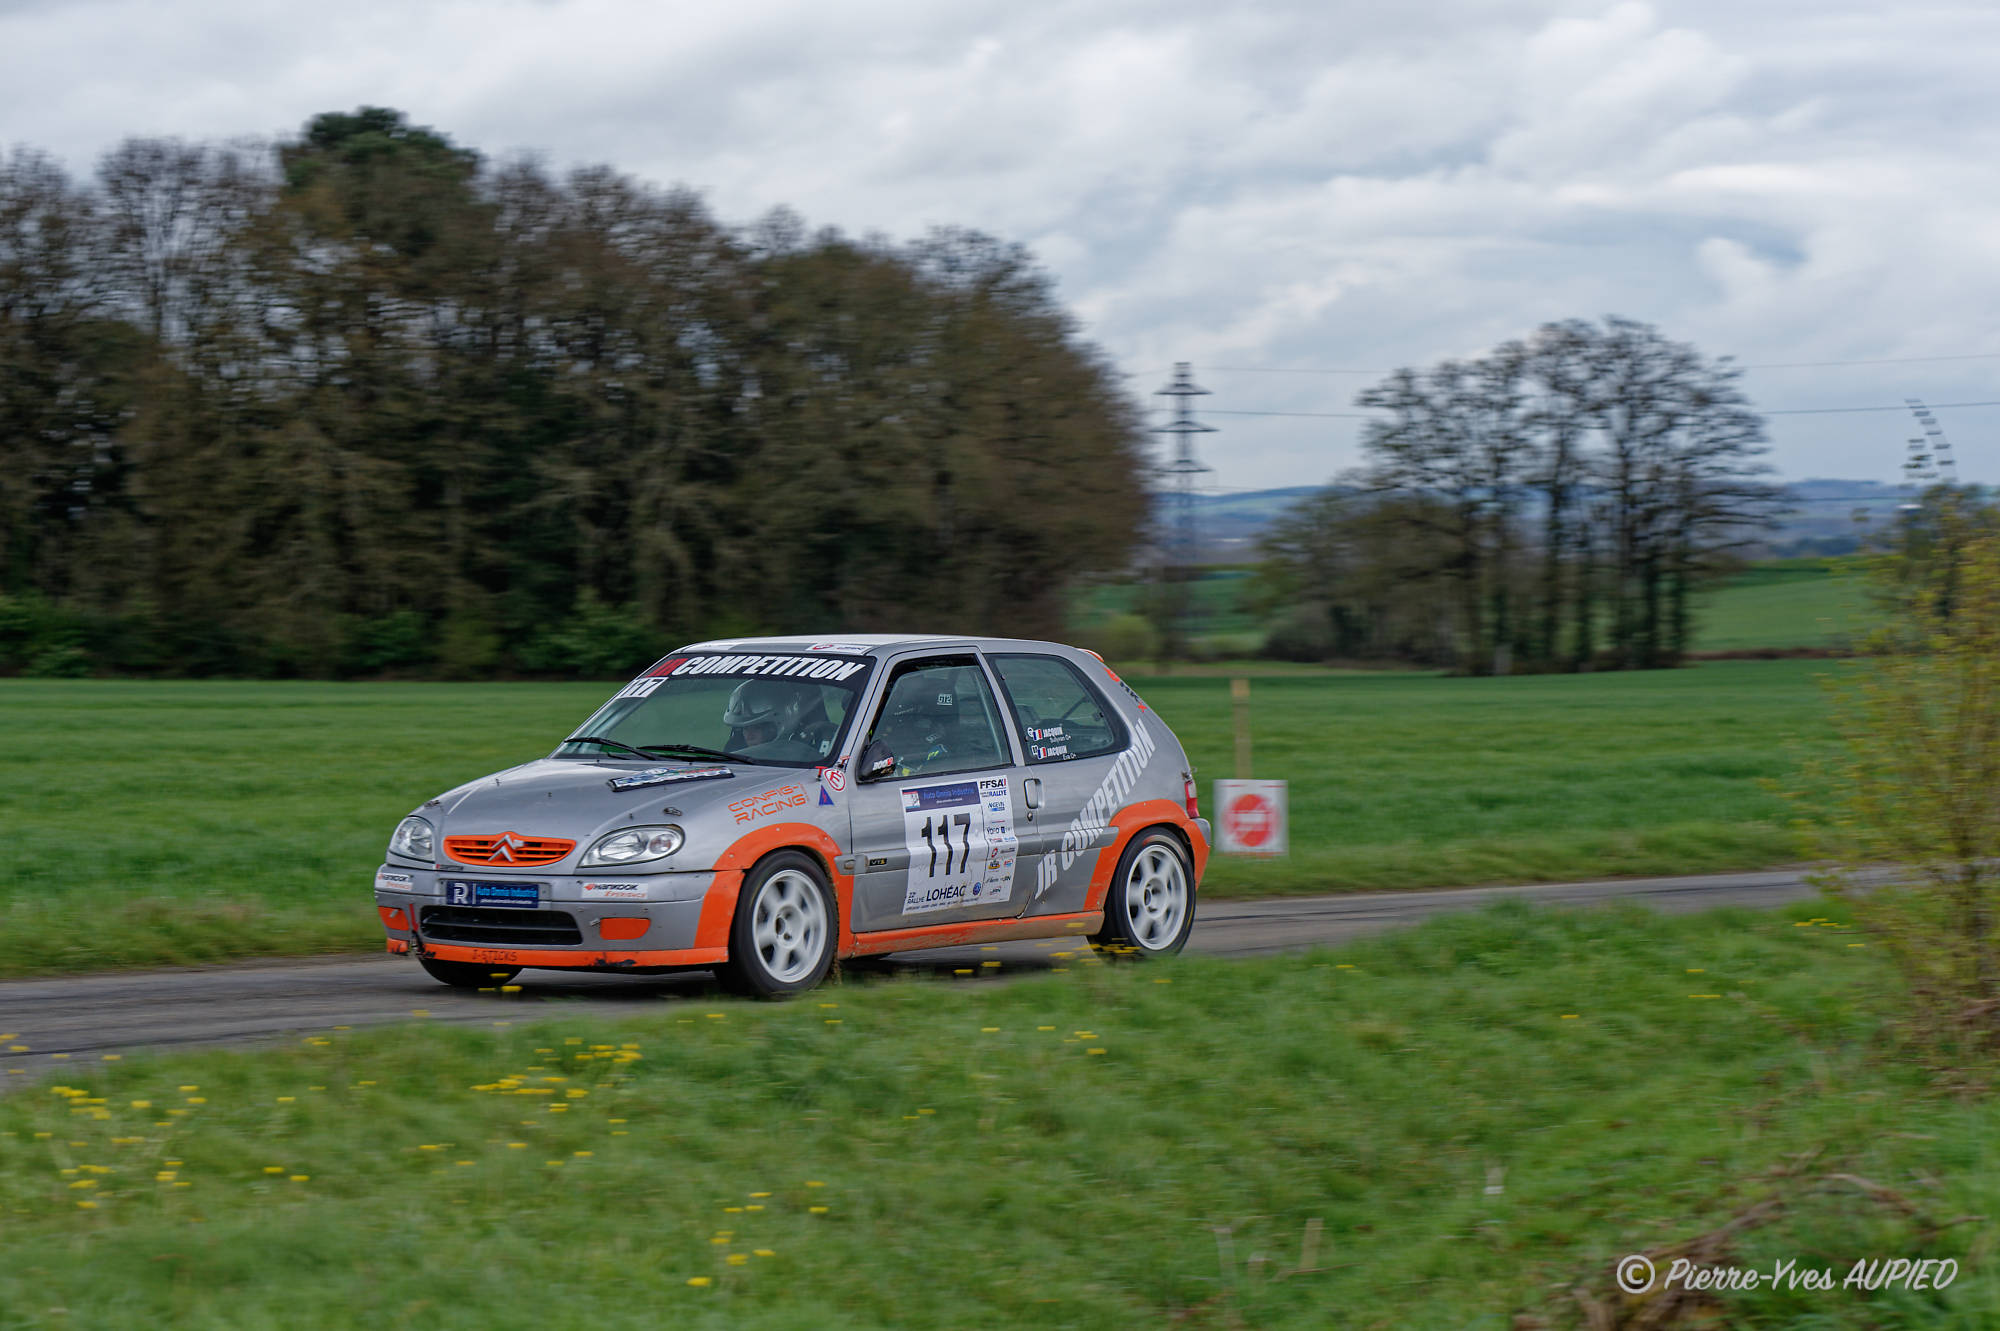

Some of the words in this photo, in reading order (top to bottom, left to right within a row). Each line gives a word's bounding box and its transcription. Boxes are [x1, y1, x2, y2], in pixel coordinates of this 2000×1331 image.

[671, 656, 866, 681] COMPETITION
[980, 779, 1004, 789] FFSA
[734, 794, 806, 825] RACING
[1035, 849, 1058, 900] JR
[1061, 718, 1156, 871] COMPETITION
[921, 813, 971, 878] 117
[907, 896, 926, 904] RALLYE
[926, 885, 967, 902] LOHÉAC
